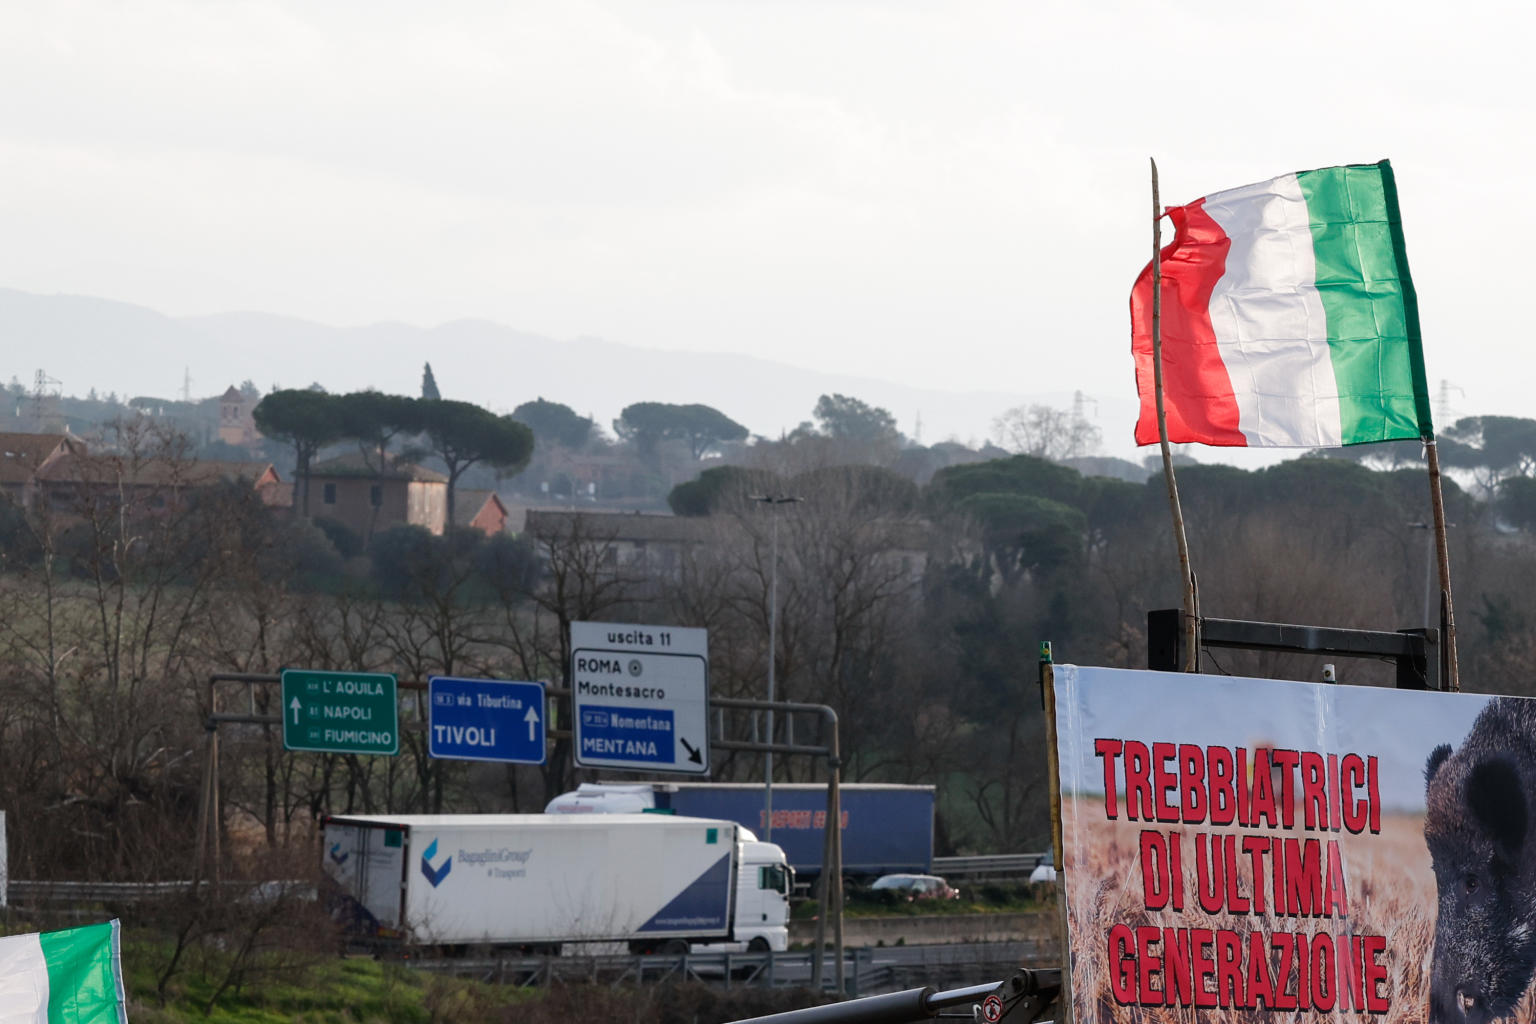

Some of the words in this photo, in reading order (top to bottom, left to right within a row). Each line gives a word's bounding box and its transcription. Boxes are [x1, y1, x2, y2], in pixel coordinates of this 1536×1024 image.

[607, 631, 653, 645] uscita
[660, 632, 671, 646] 11
[577, 658, 622, 674] ROMA
[336, 681, 384, 696] AQUILA
[578, 681, 665, 699] Montesacro
[457, 692, 472, 706] via
[477, 693, 522, 710] Tiburtina
[323, 706, 372, 720] NAPOLI
[611, 713, 672, 731] Nomentana
[324, 729, 392, 745] FIUMICINO
[434, 724, 495, 747] TIVOLI
[583, 738, 658, 756] MENTANA
[1094, 738, 1380, 835] TREBBIATRICI
[1139, 830, 1184, 913] DI
[1195, 833, 1348, 919] ULTIMA
[1108, 923, 1390, 1015] GENERAZIONE
